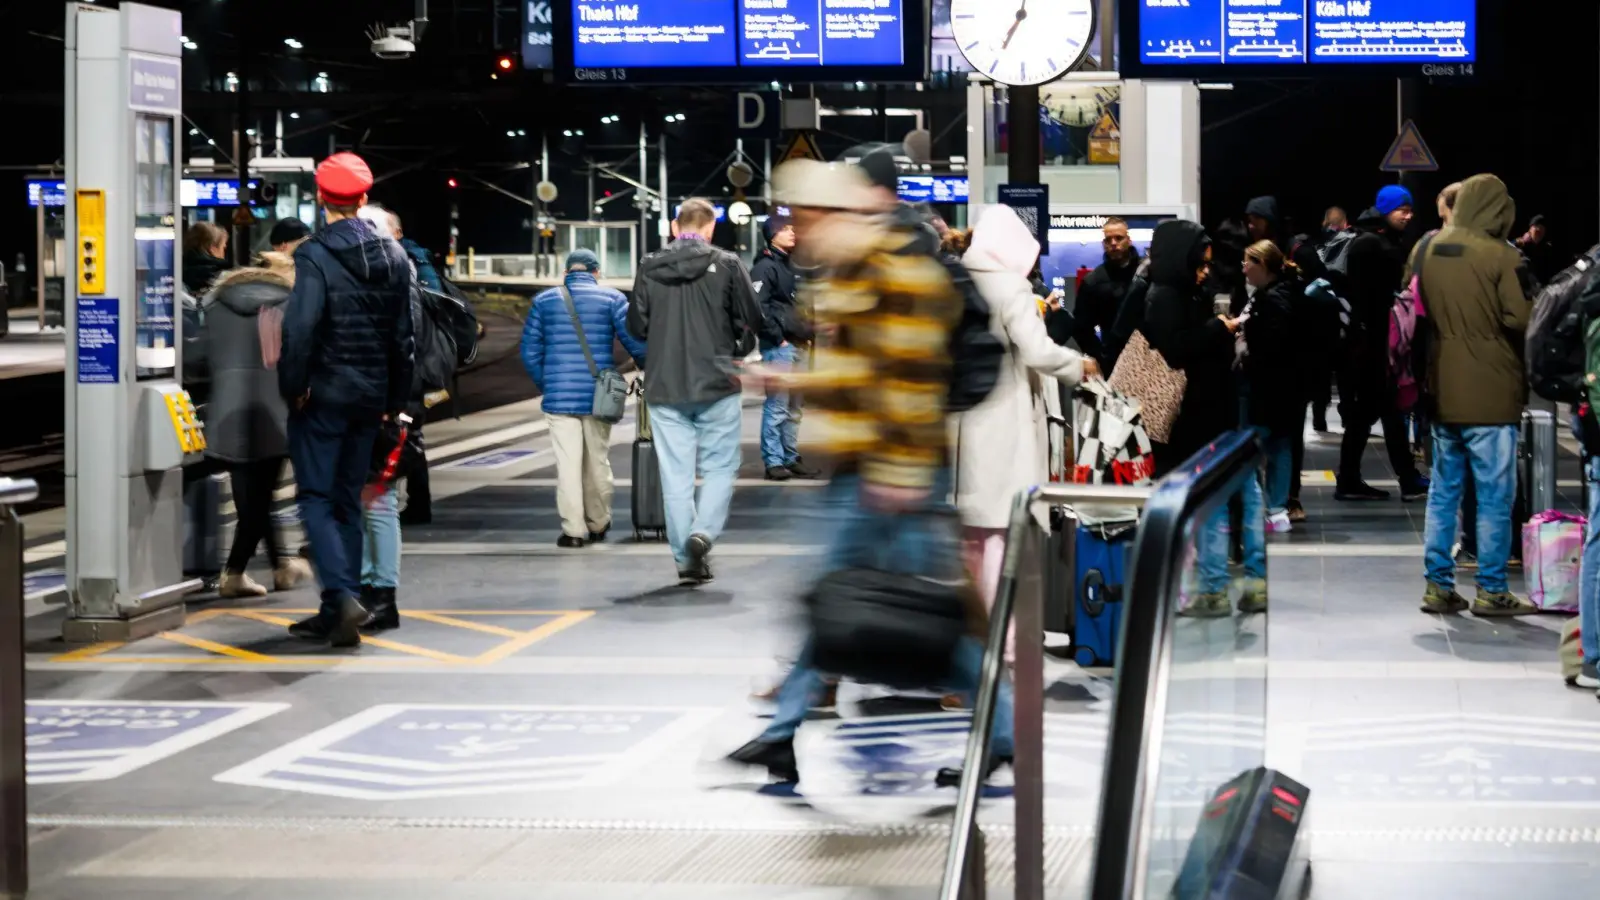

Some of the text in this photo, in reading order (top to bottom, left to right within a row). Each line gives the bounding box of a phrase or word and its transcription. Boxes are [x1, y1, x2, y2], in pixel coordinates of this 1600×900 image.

[578, 4, 639, 21] Thale Hbf
[1315, 1, 1345, 16] Köln
[1347, 1, 1371, 16] Hbf
[575, 68, 626, 81] Gleis 13
[1422, 64, 1474, 76] Gleis 14
[738, 92, 766, 129] D
